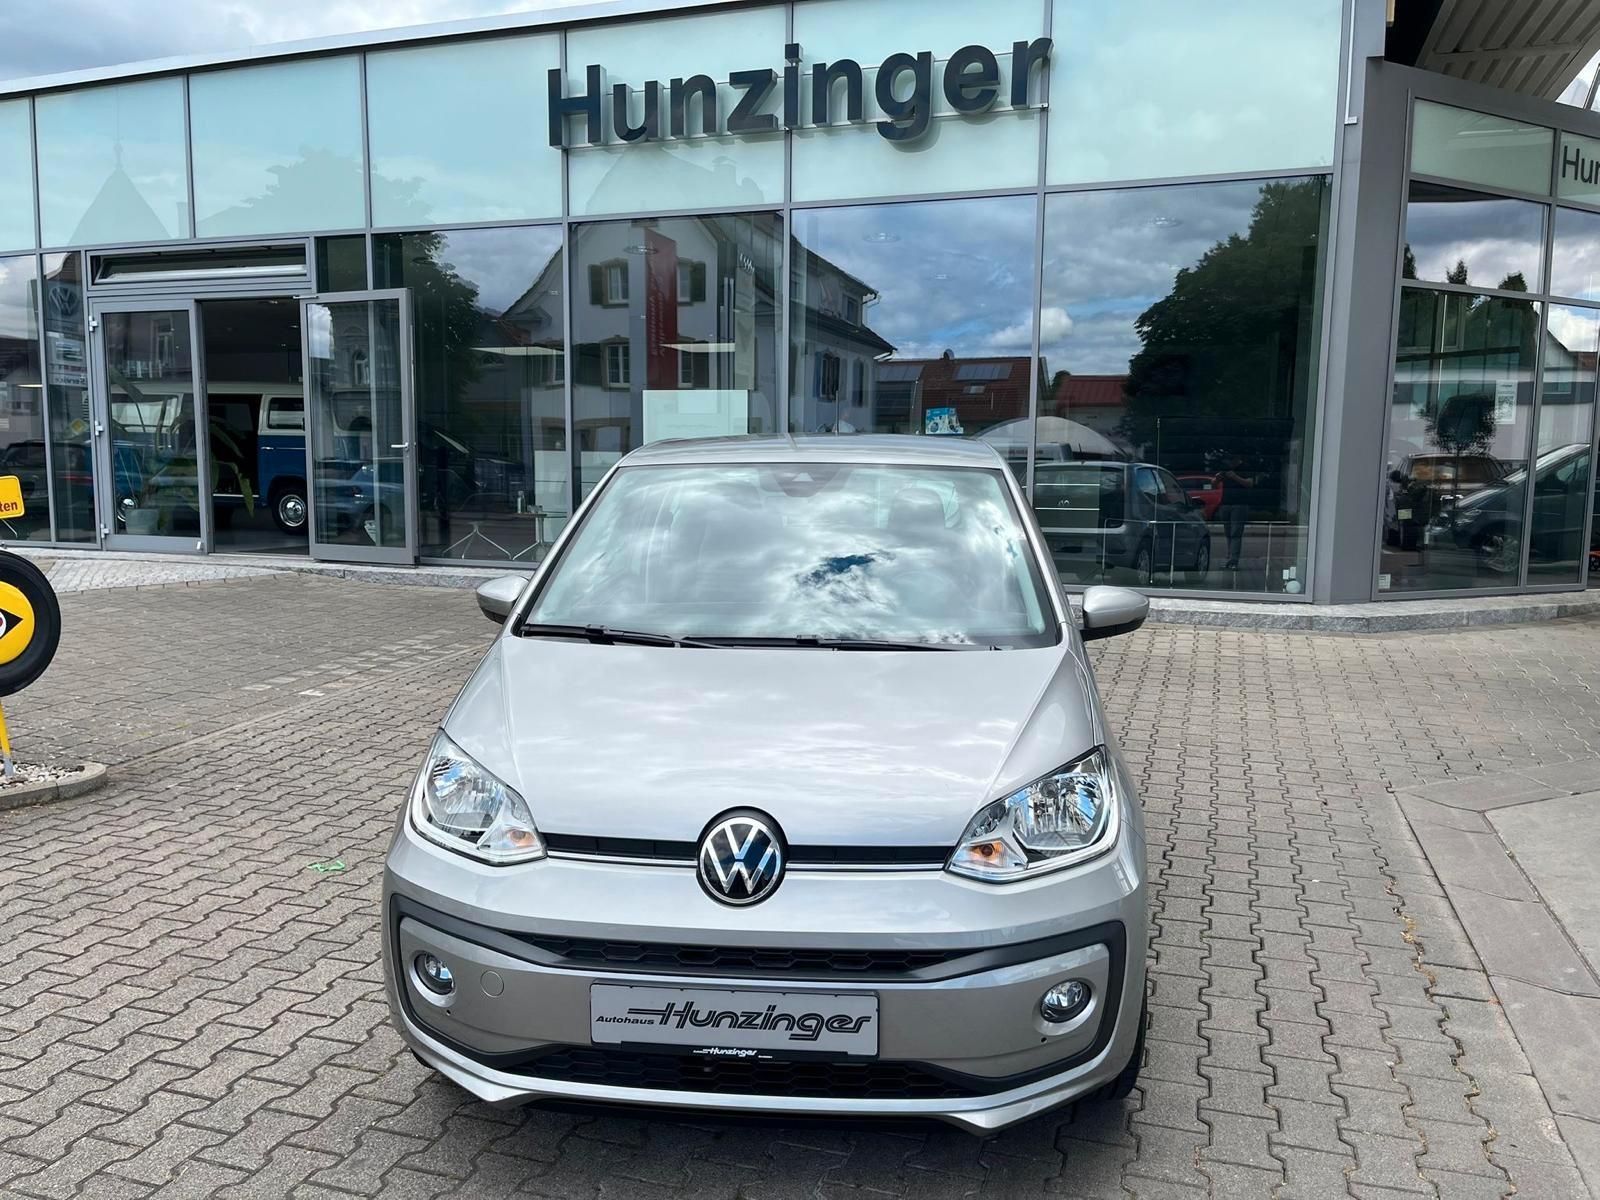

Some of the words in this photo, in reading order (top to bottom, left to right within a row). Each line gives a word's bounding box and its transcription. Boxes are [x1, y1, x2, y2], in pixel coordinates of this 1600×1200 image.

[547, 37, 1053, 148] Hunzinger
[595, 1015, 655, 1025] Autohaus
[627, 1001, 872, 1041] Hunzinger
[704, 1047, 757, 1058] Hunzinger
